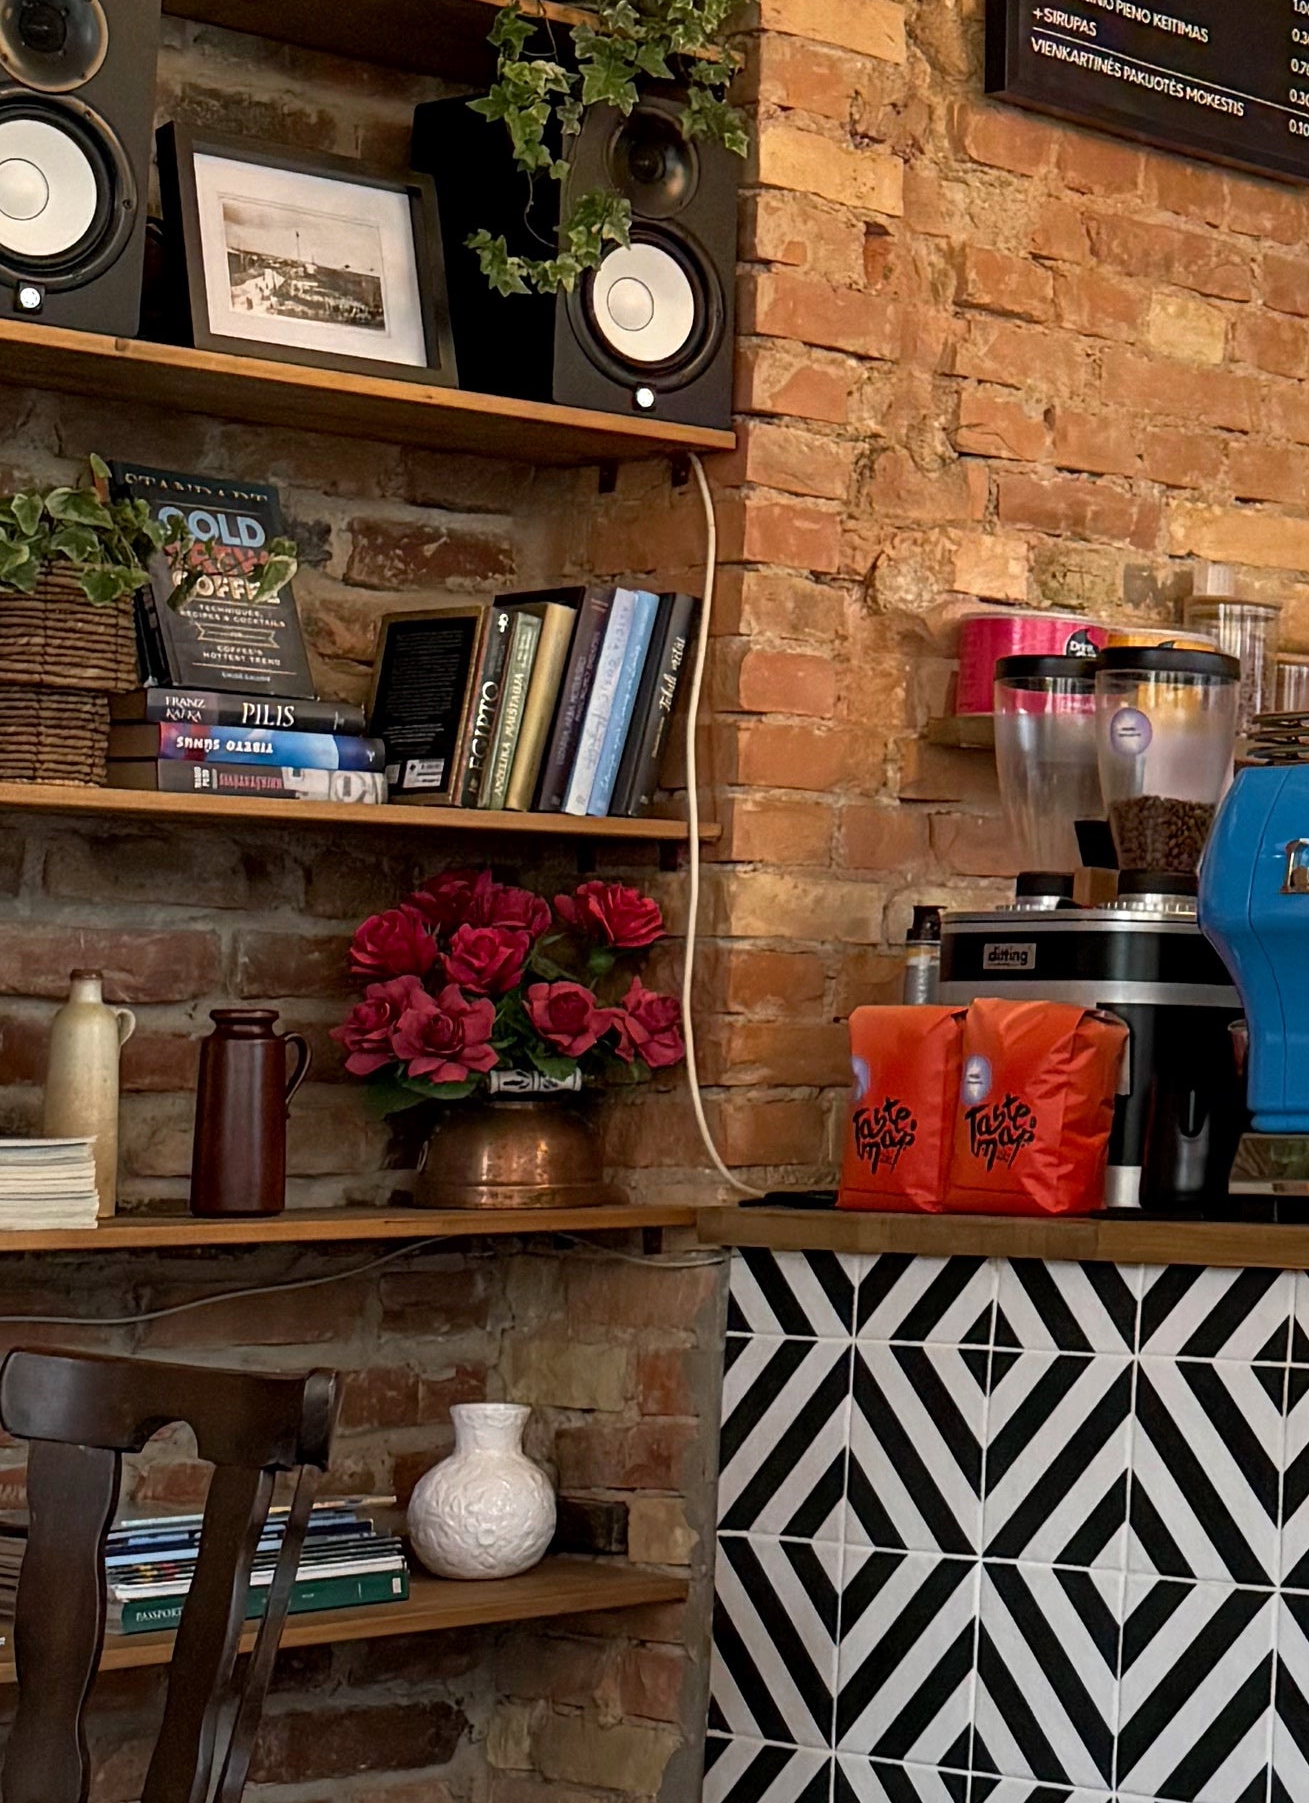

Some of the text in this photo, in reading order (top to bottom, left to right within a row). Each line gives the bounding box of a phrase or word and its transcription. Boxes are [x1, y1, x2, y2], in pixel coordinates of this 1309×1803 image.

[1033, 8, 1096, 36] +SIRUPAS
[1116, 0, 1151, 23] PIENO
[1153, 13, 1208, 43] KEITIMAS
[1031, 37, 1309, 137] VIENKARTINĖS PAKUOTĖS MOKESTIS 0.10
[241, 701, 295, 728] PILIS
[226, 740, 274, 754] TIBETO
[853, 1096, 912, 1159] Taste
[965, 1093, 1032, 1157] Taste
